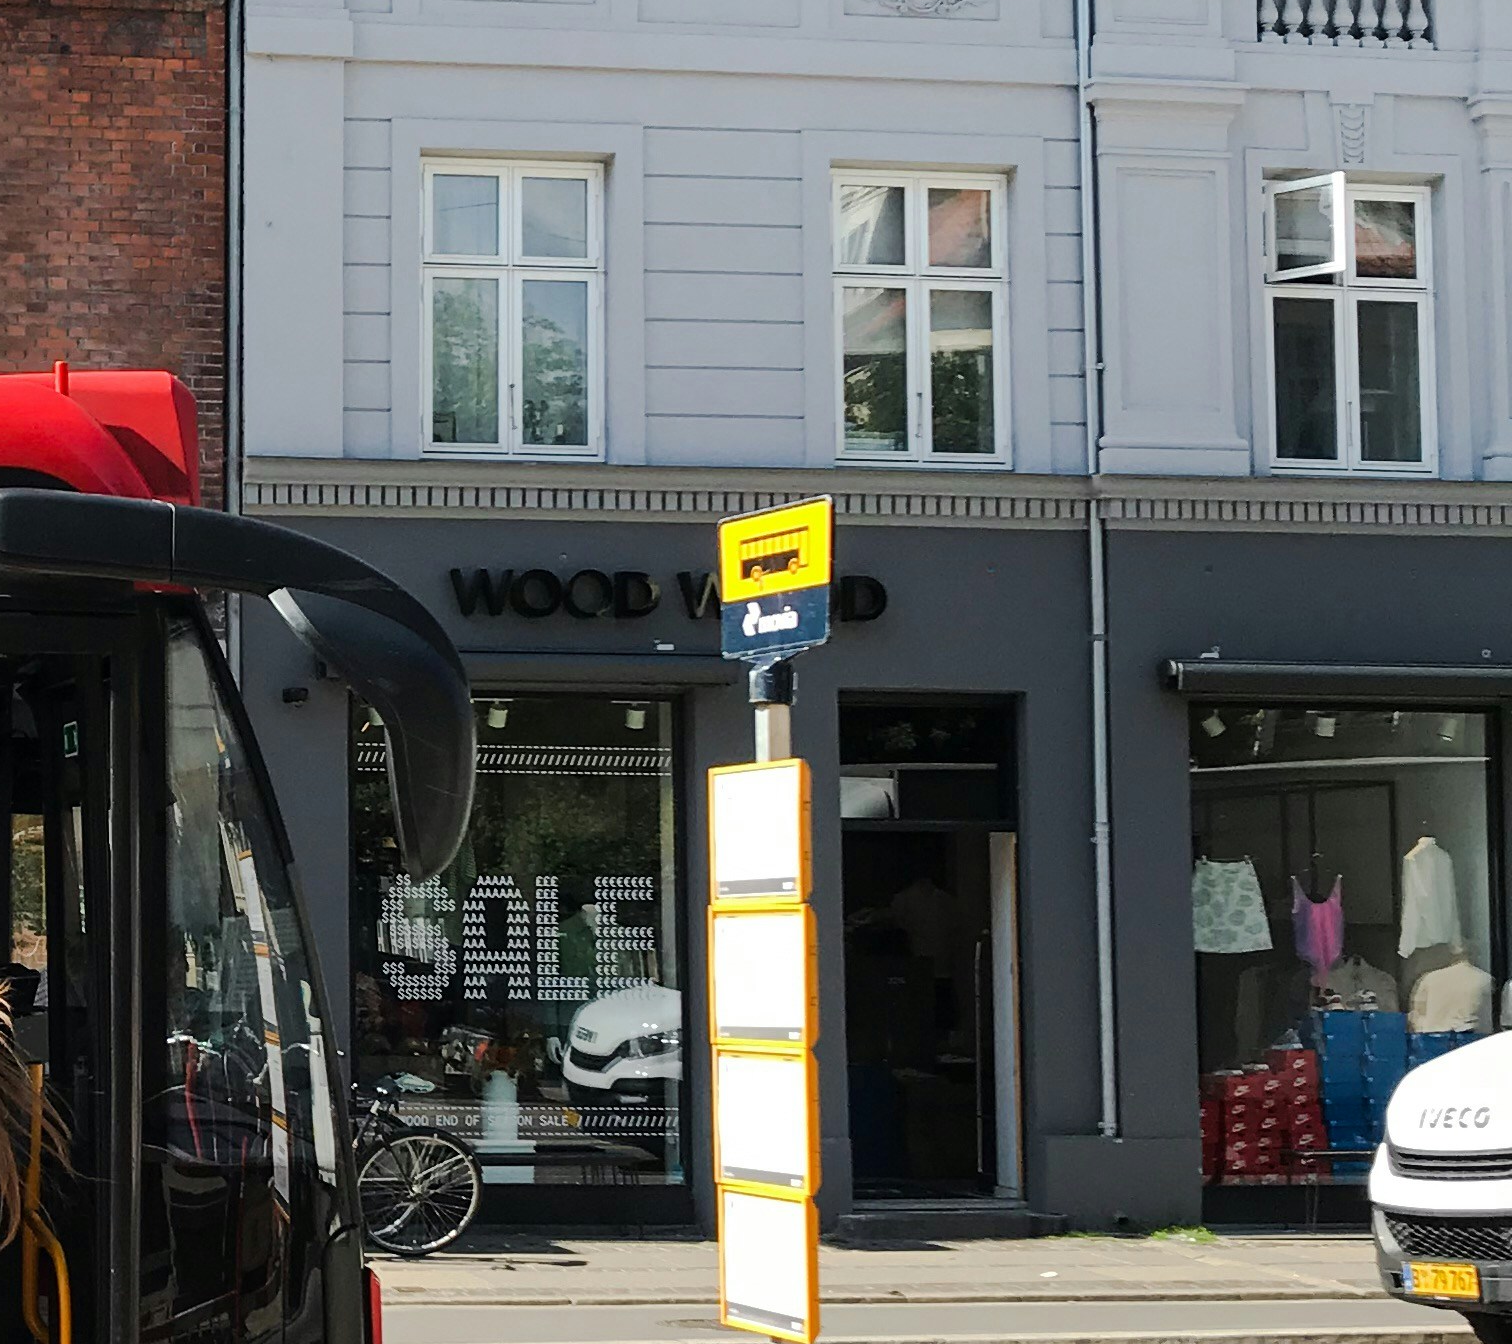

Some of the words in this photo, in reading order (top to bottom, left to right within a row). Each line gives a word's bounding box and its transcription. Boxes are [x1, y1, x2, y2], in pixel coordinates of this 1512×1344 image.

[449, 568, 661, 618] WOOD
[676, 571, 887, 622] WD
[381, 873, 655, 1001] SALE
[436, 1115, 459, 1127] END
[465, 1115, 480, 1127] OF
[539, 1115, 570, 1127] SALE
[1419, 1107, 1491, 1129] IVECO
